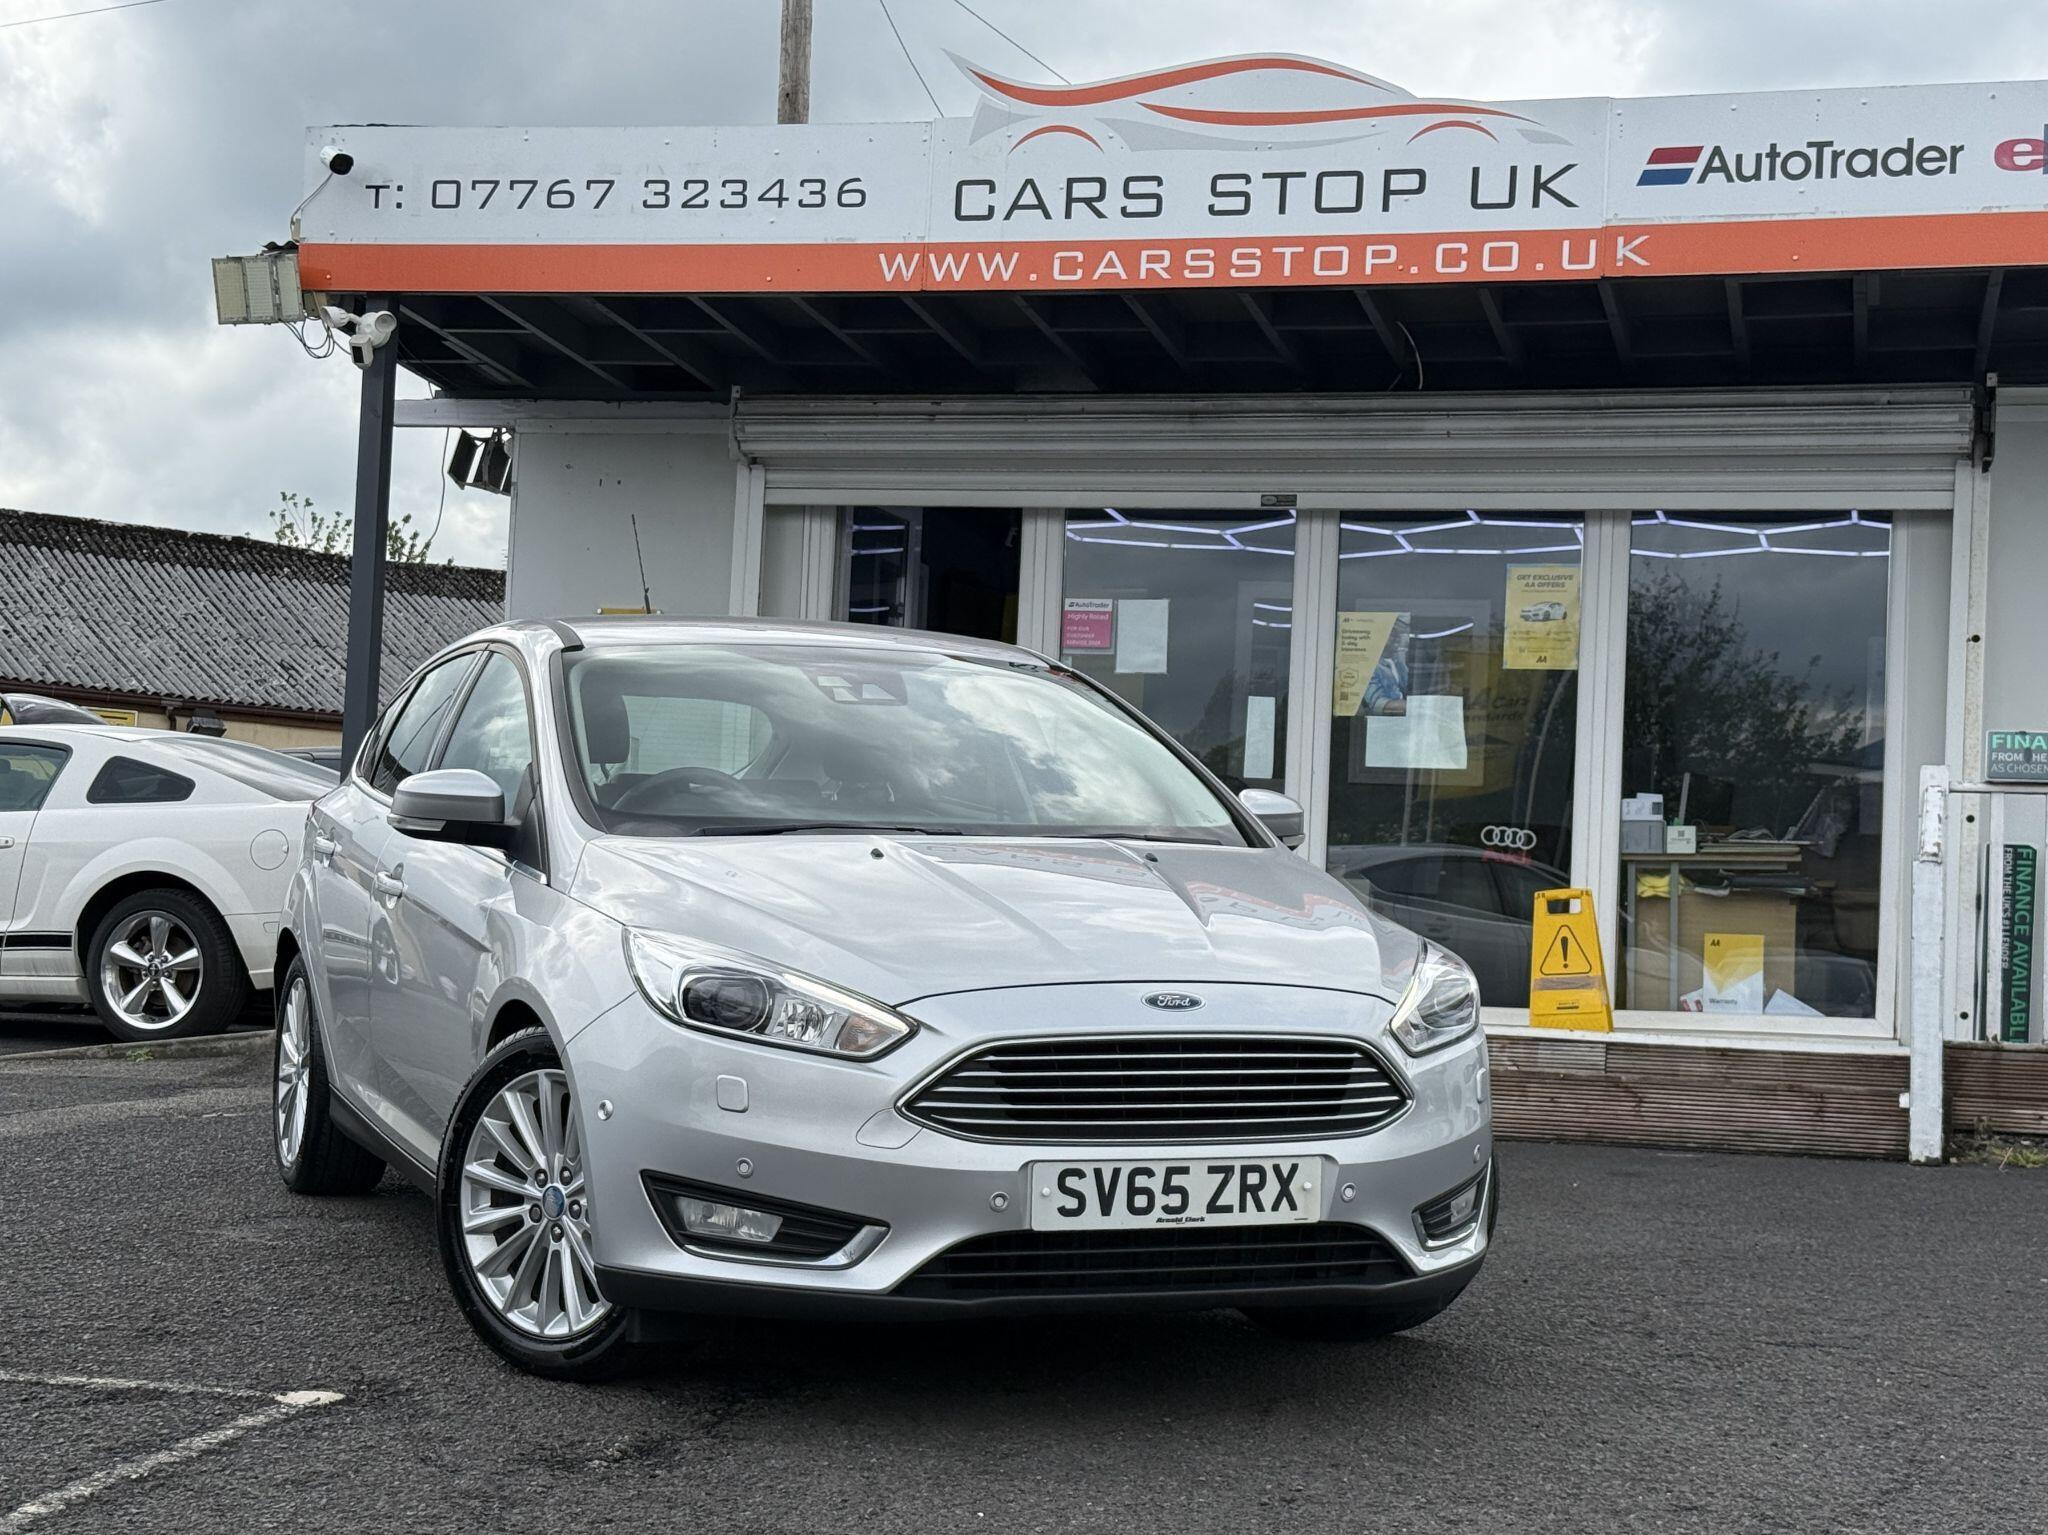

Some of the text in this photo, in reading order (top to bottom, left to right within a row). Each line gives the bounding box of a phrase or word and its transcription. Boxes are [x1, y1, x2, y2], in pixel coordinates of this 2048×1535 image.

[1697, 138, 1964, 185] AutoTrader
[365, 177, 867, 210] T: 07767 323436
[954, 162, 1580, 222] CARS STOP UK
[1991, 763, 2005, 773] AS
[1992, 752, 2023, 761] FROM
[2003, 847, 2013, 874] FROM
[2003, 875, 2012, 894] THE
[2014, 847, 2033, 936] FINANCE
[1157, 995, 1191, 1006] Ford
[1056, 1162, 1300, 1218] SV65 ZRX
